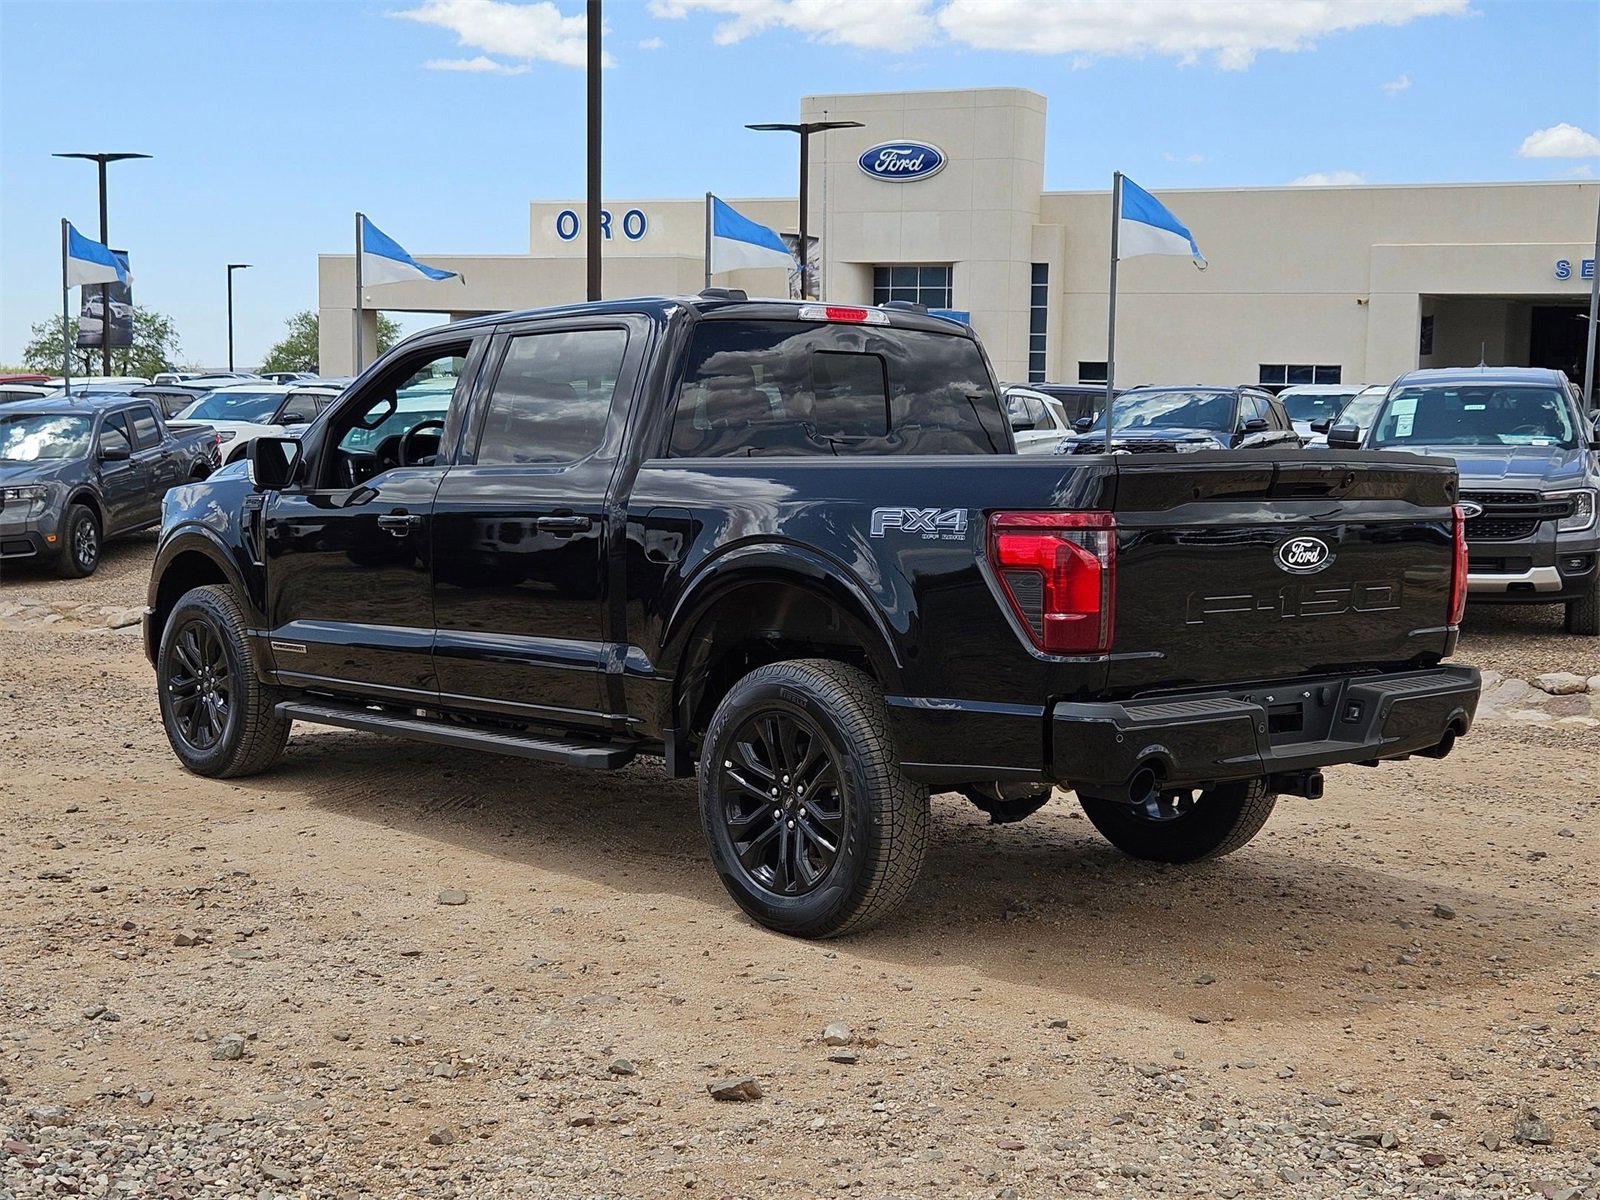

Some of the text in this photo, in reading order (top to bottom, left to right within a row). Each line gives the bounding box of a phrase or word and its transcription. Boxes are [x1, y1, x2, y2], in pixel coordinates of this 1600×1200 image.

[874, 149, 925, 172] Ford
[870, 507, 968, 538] FX4
[1288, 541, 1320, 564] Ford
[1186, 580, 1401, 624] F-150
